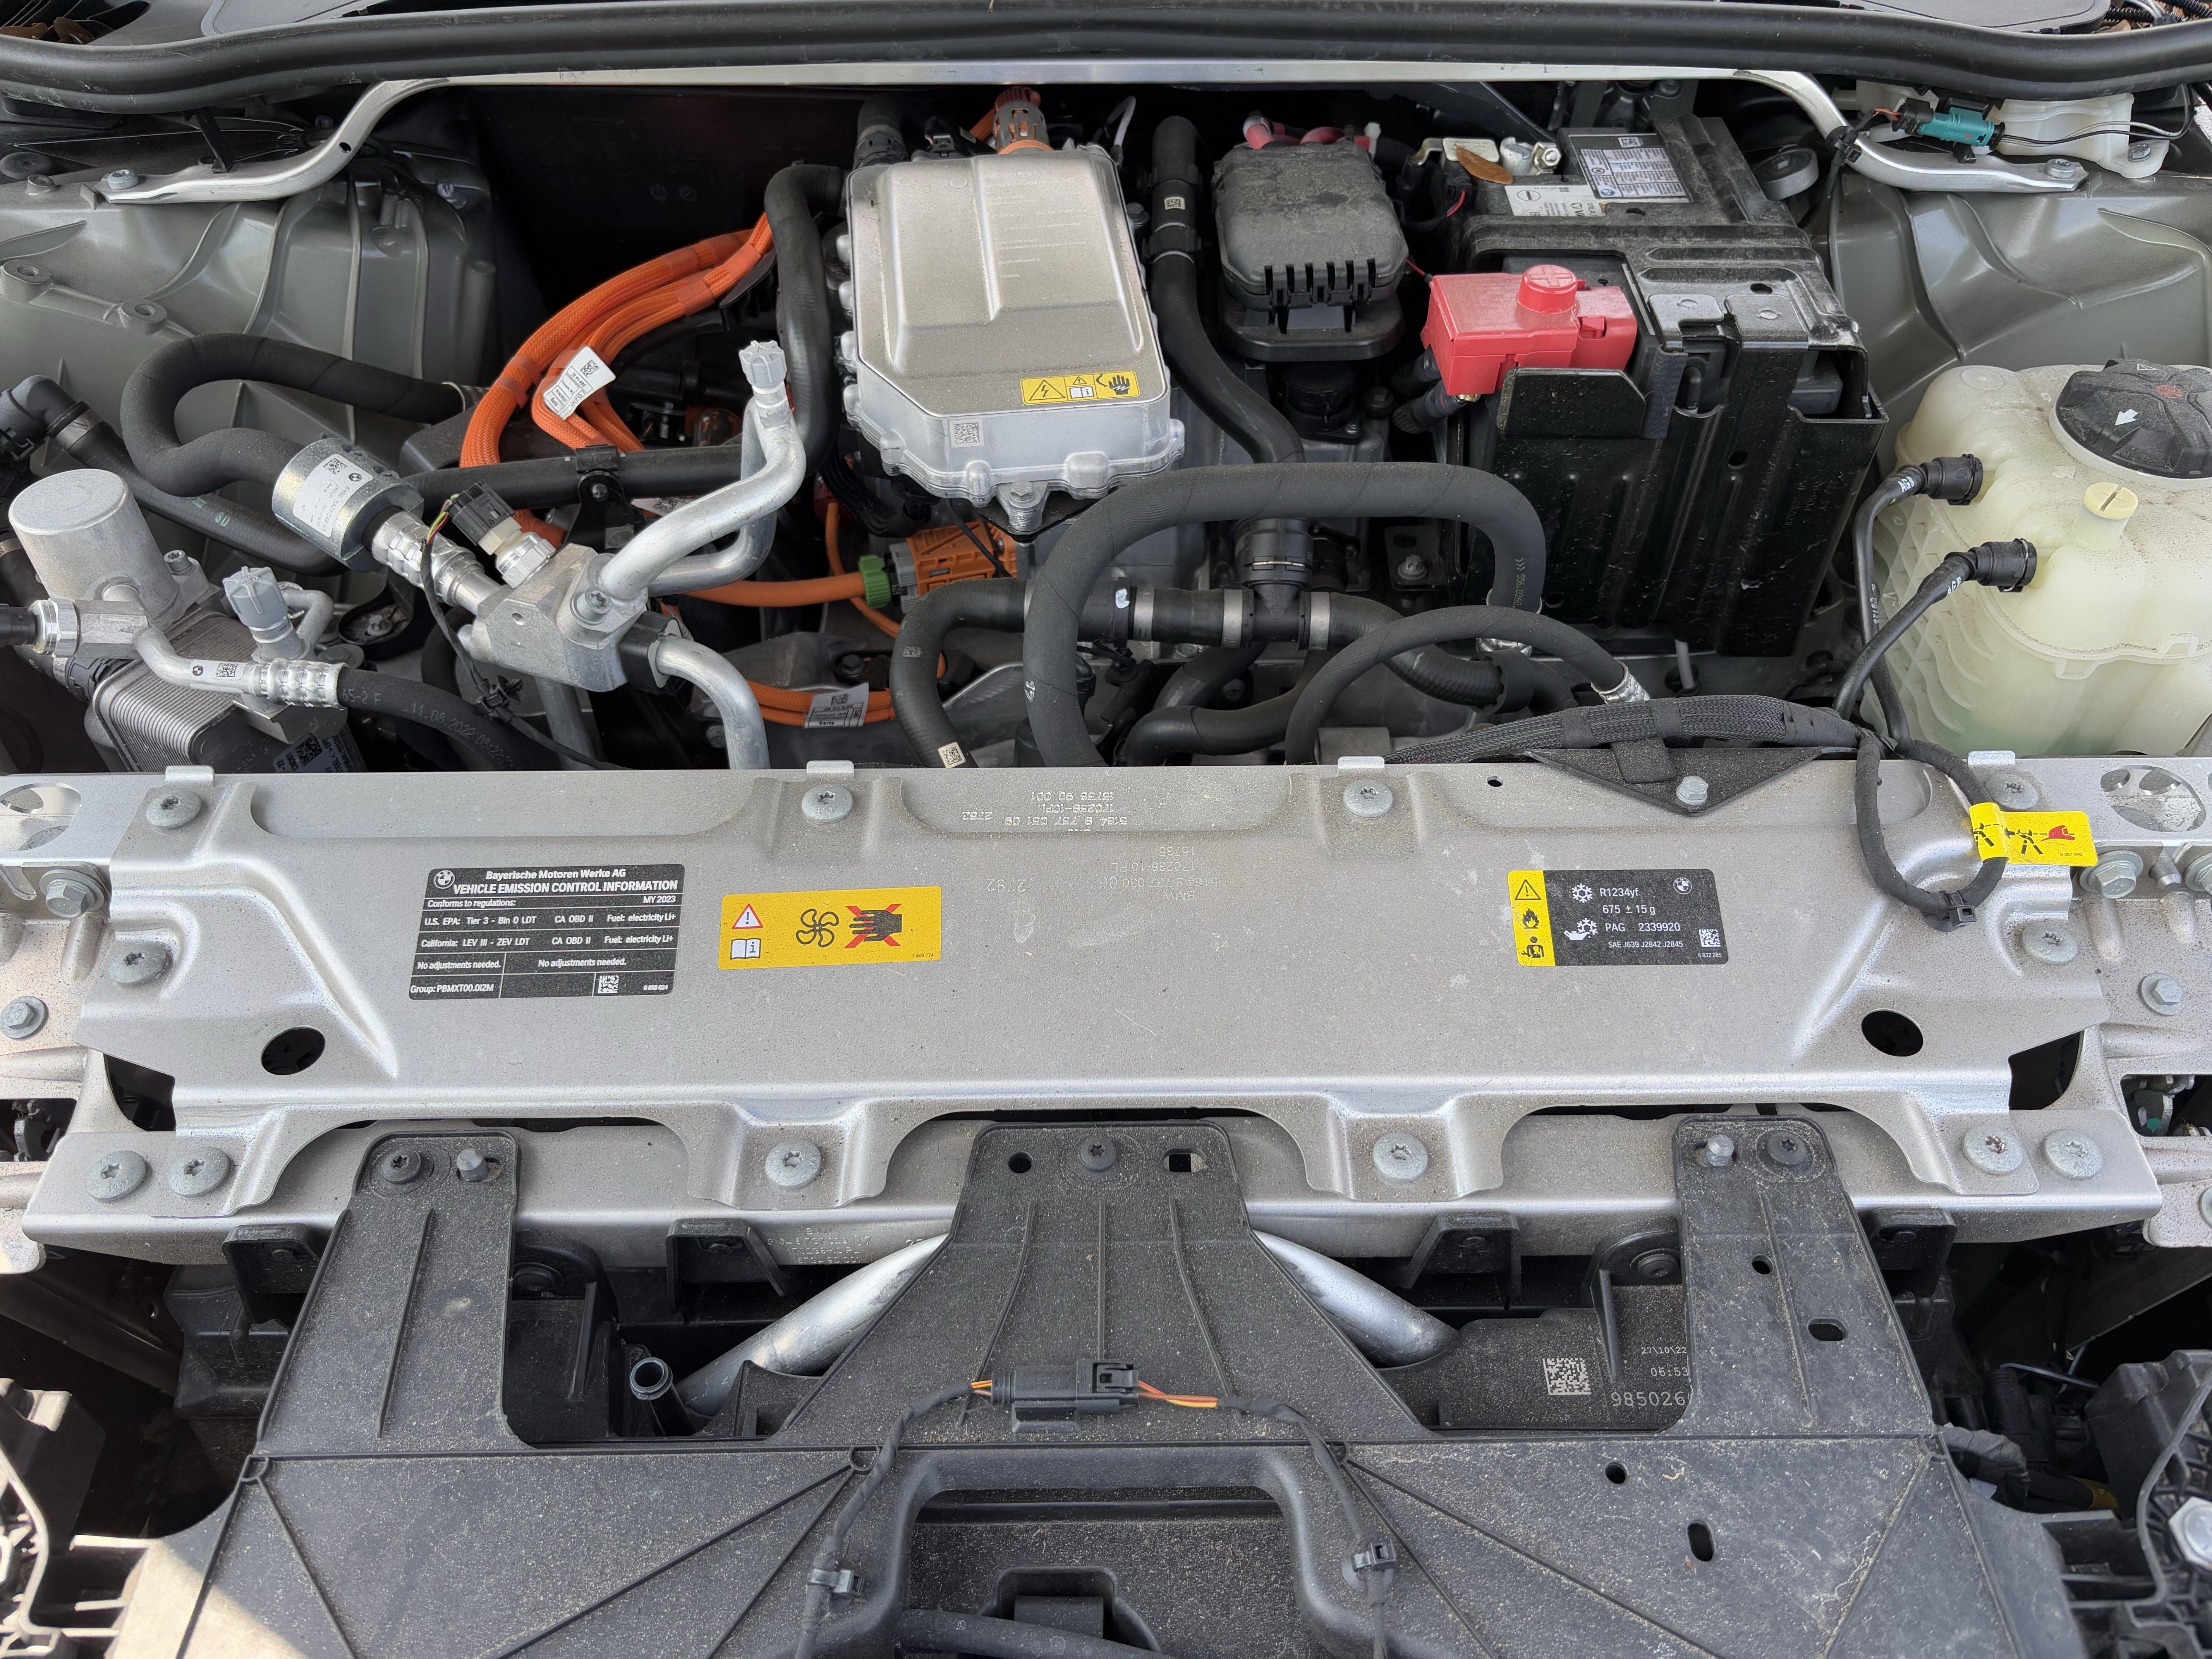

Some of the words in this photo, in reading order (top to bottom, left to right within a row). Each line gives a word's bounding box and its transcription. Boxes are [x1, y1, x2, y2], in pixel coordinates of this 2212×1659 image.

[1897, 476, 1914, 493] AGB
[486, 871, 537, 881] Bayerische
[539, 870, 579, 879] Motoren
[581, 869, 611, 878] Werke
[612, 869, 626, 878] AG
[453, 884, 497, 894] VEHICLE
[498, 883, 550, 894] EMISSION
[551, 882, 601, 893] CONTROL
[603, 880, 678, 891] INFORMATION
[1600, 888, 1640, 898] R1234yf
[428, 900, 464, 908] Conforms
[473, 899, 516, 908] regulations:
[1602, 905, 1621, 914] 675
[1635, 905, 1647, 914] 15
[1649, 907, 1656, 916] g
[443, 917, 461, 925] EPA:
[467, 917, 481, 925] Tier
[483, 917, 489, 925] 3
[522, 916, 537, 924] LDT
[607, 914, 625, 922] Fuel:
[628, 913, 664, 922] electricity
[1605, 923, 1625, 932] PAG
[1638, 922, 1681, 932] 2339920
[421, 939, 459, 947] California:
[463, 938, 478, 946] LEV
[497, 938, 513, 946] ZEV
[515, 938, 531, 946] LDT
[552, 937, 563, 945] CA
[566, 936, 583, 945] OBD
[605, 936, 623, 944] Fuel:
[625, 935, 662, 944] electricity
[417, 962, 428, 970] No
[429, 961, 472, 970] adjustments
[473, 960, 501, 969] needed.
[550, 958, 596, 968] adjustments
[597, 958, 627, 966] needed.
[410, 985, 436, 994] Group:
[1650, 1367, 1689, 1377] 06:53
[1611, 1391, 1690, 1407] 985026
